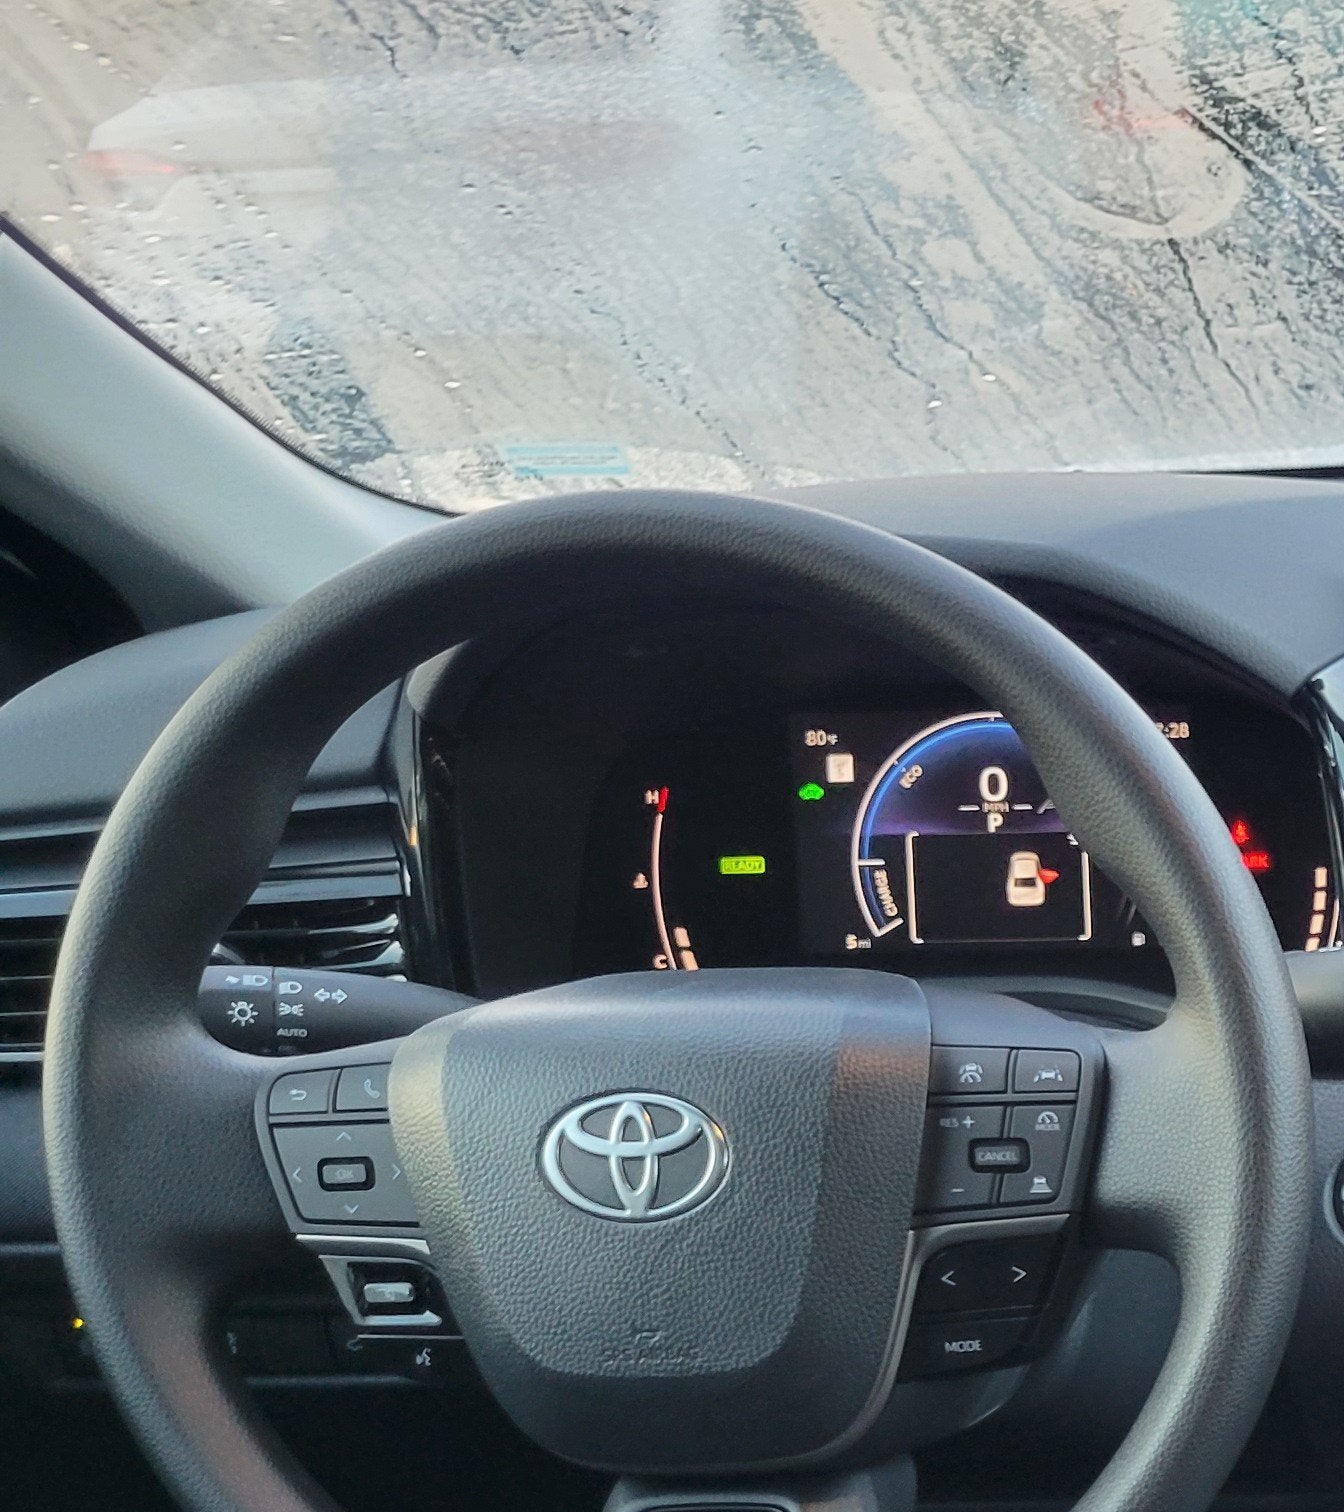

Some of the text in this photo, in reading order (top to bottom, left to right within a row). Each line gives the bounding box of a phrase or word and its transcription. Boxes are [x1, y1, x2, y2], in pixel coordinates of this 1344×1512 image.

[979, 766, 1009, 801] 0
[986, 812, 1004, 833] P
[276, 1028, 308, 1038] AUTO
[978, 1152, 1017, 1162] CANCEL
[944, 1339, 983, 1353] MODE
